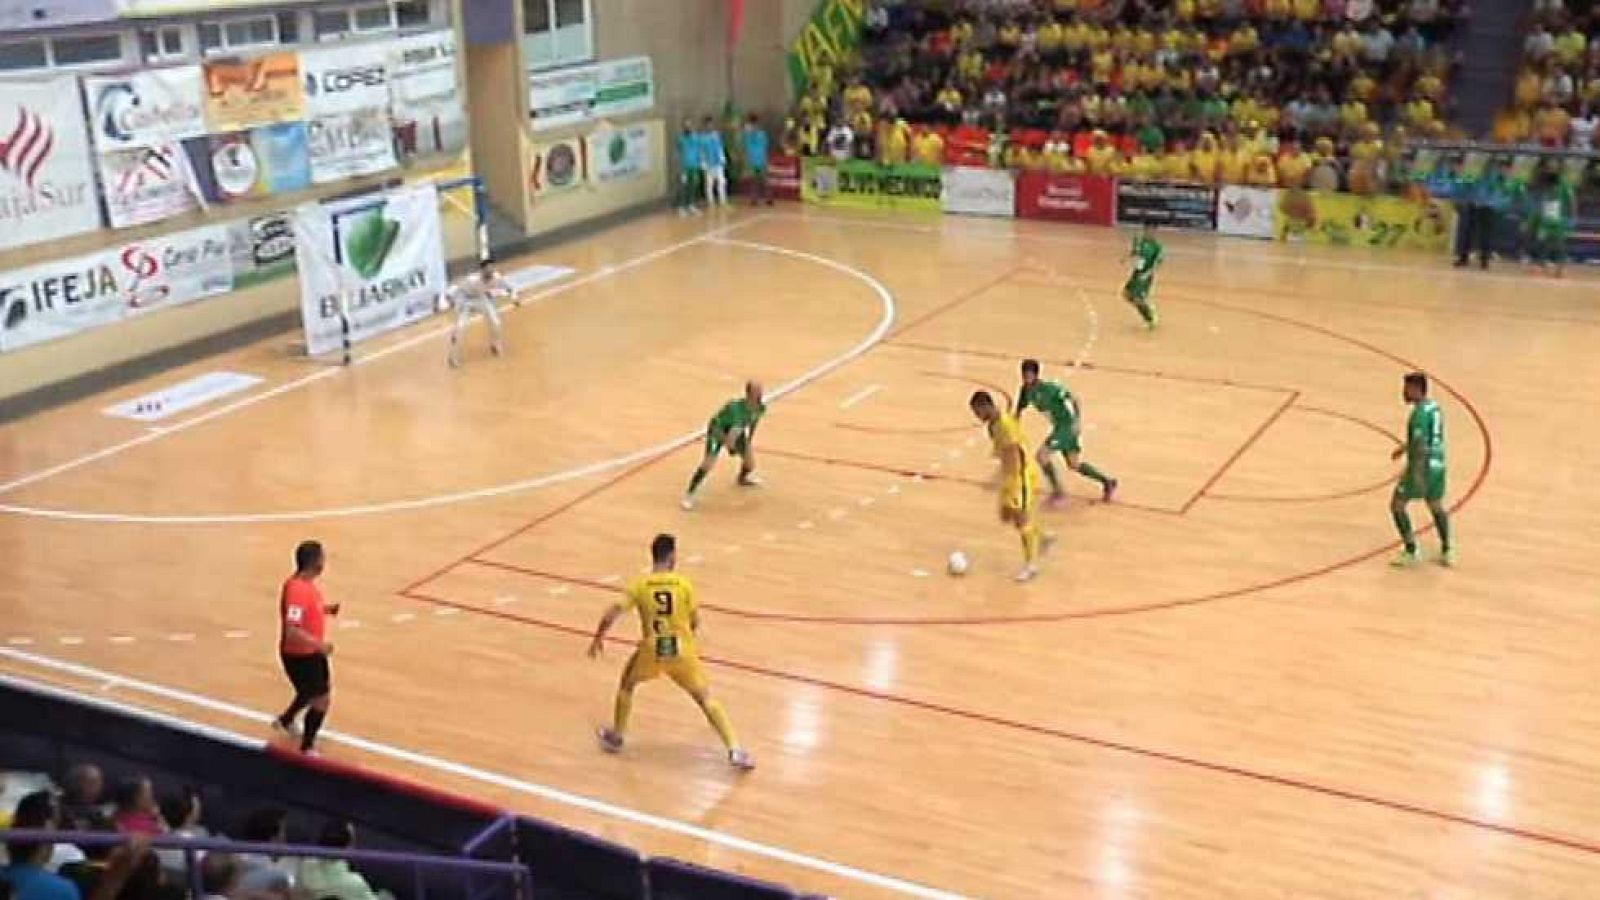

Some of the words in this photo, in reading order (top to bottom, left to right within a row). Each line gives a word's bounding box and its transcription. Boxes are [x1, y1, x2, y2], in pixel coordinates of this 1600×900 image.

[324, 66, 385, 93] LOPEZ
[0, 181, 86, 219] ajaSur
[31, 265, 118, 312] IFEJA
[653, 590, 672, 615] 9
